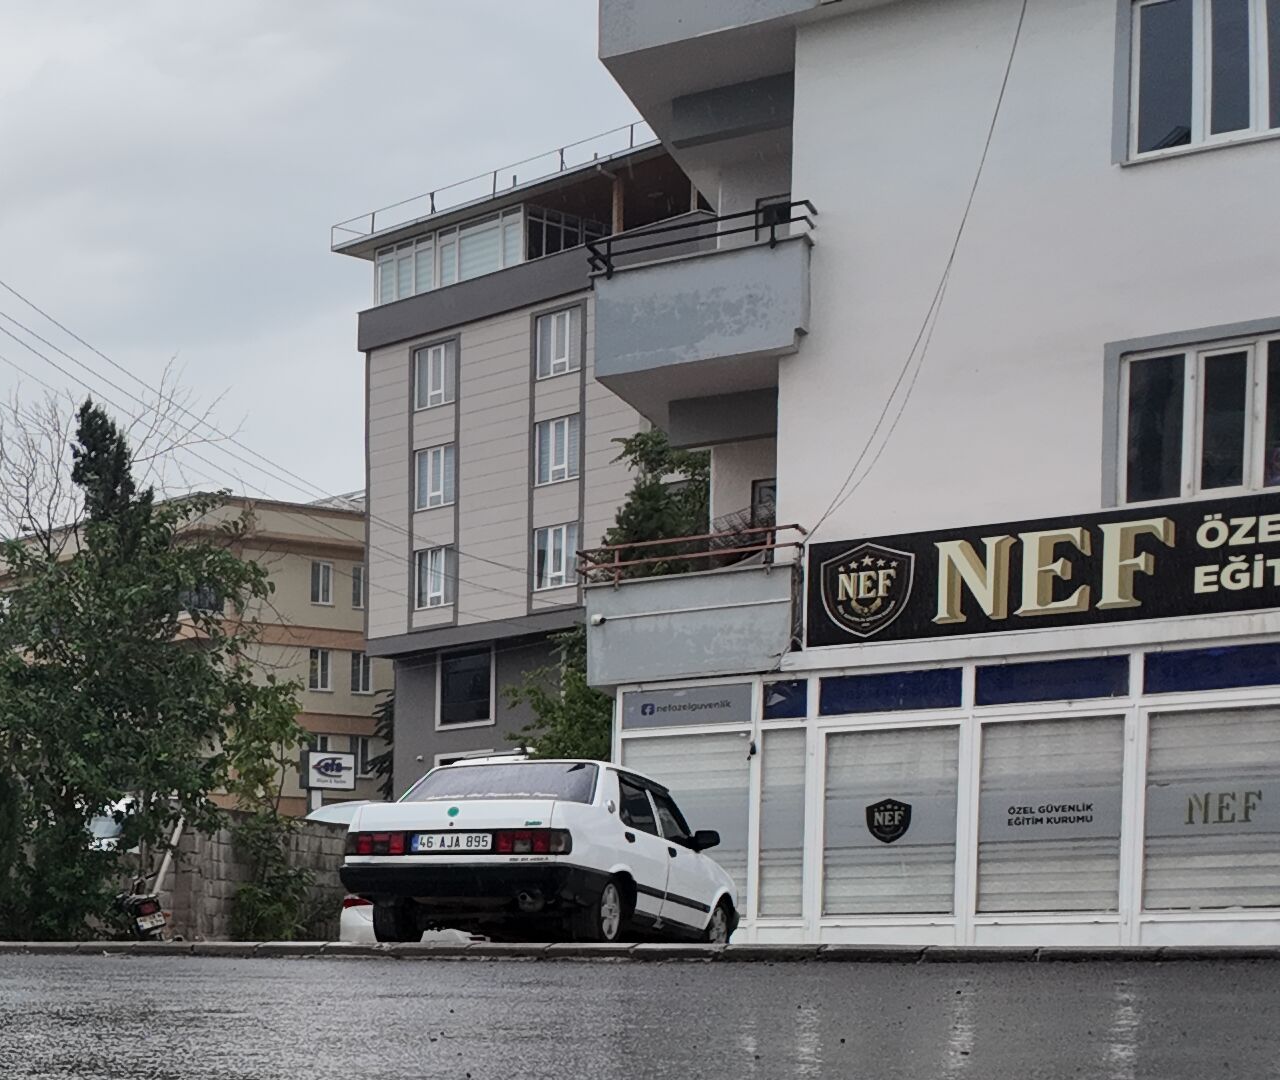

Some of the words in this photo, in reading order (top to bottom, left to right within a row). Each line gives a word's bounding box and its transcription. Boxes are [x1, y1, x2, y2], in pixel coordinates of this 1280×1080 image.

[1196, 513, 1280, 549] ÖZE
[838, 569, 897, 600] NEF
[932, 517, 1175, 624] NEF
[1194, 554, 1280, 594] EĞİT
[874, 811, 904, 826] NEF
[1007, 805, 1036, 815] ÖZEL
[1038, 803, 1093, 814] GÜVENLİK
[1007, 816, 1044, 826] EĞİTİM
[1046, 815, 1093, 825] KURUMU
[1184, 790, 1262, 825] NEF
[420, 837, 433, 848] 46
[440, 836, 460, 848] AJA
[466, 835, 488, 848] 895
